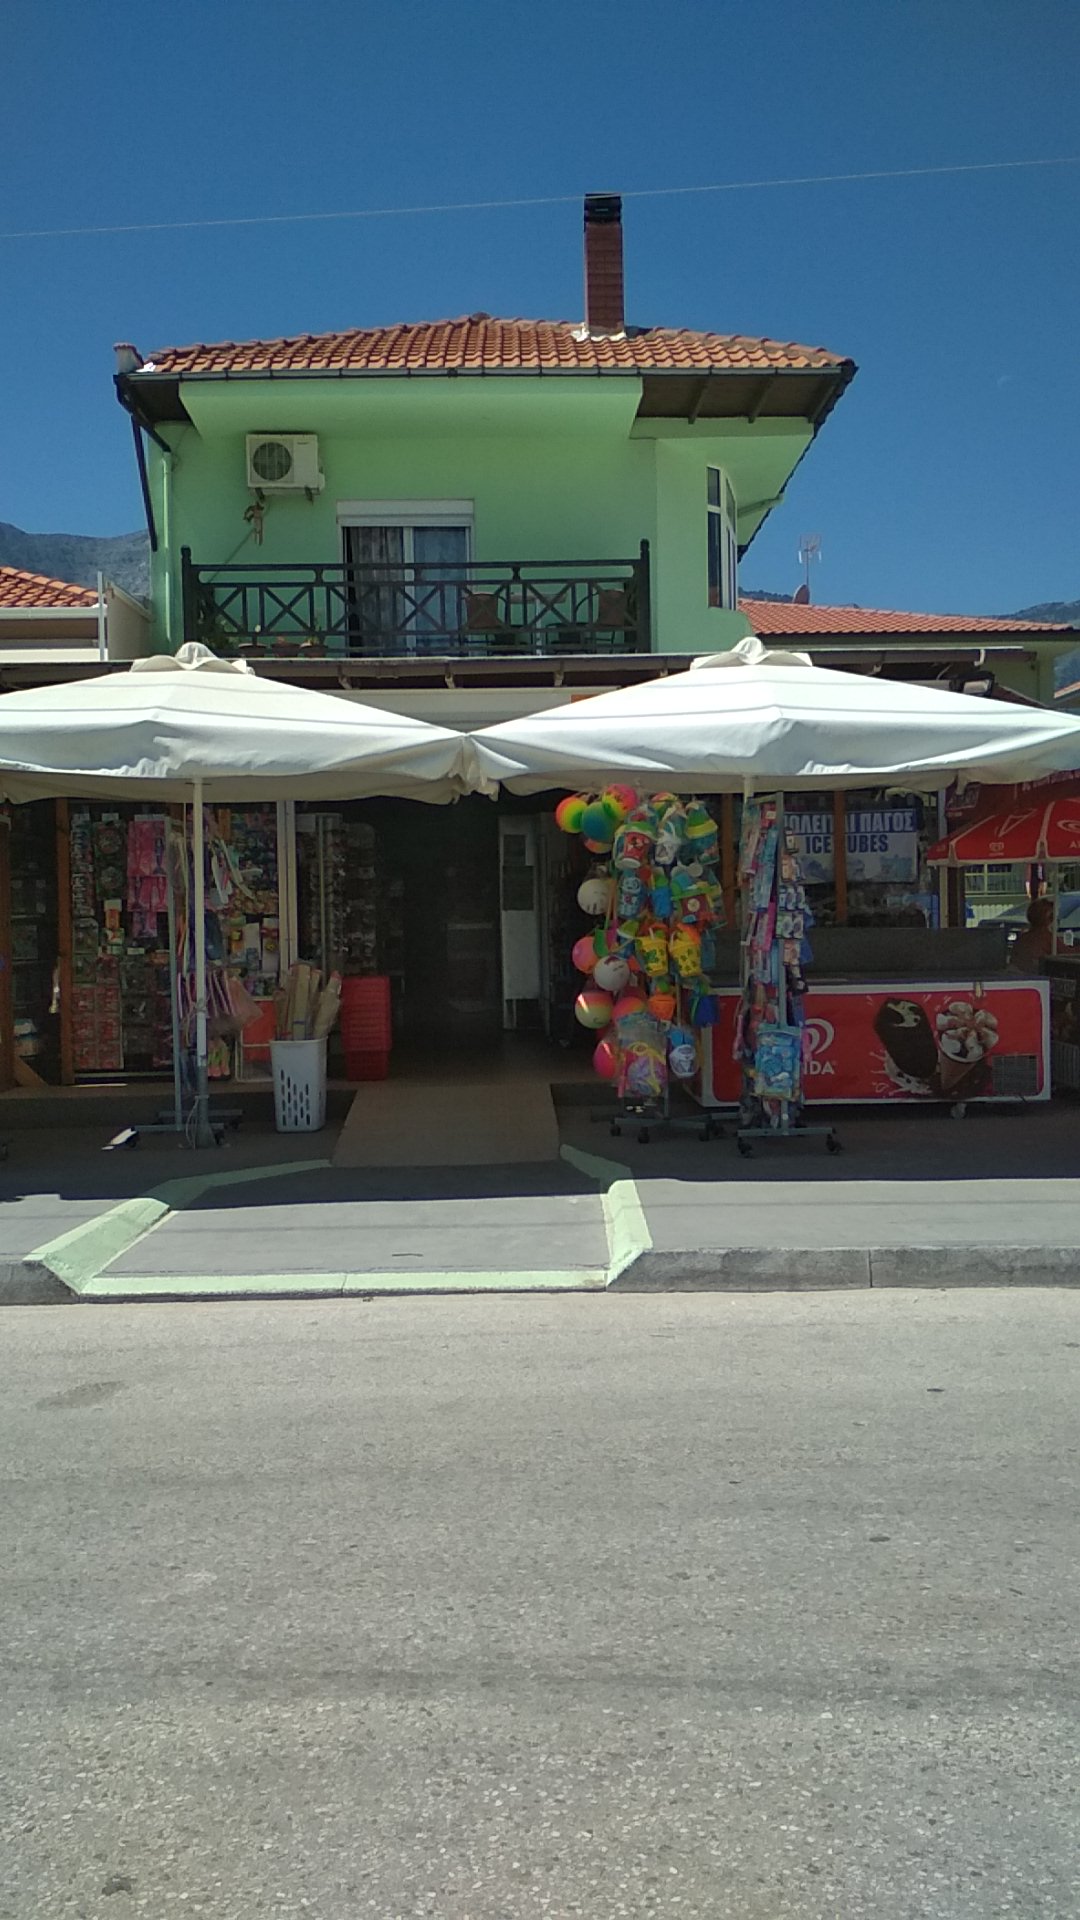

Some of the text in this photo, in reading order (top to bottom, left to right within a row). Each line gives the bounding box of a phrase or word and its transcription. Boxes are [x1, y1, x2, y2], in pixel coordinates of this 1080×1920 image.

[784, 812, 913, 833] ΩΛΕΙΤΙ ΠΑΓΟΣ
[805, 834, 888, 854] ICE UBES
[803, 1060, 835, 1075] IDA
